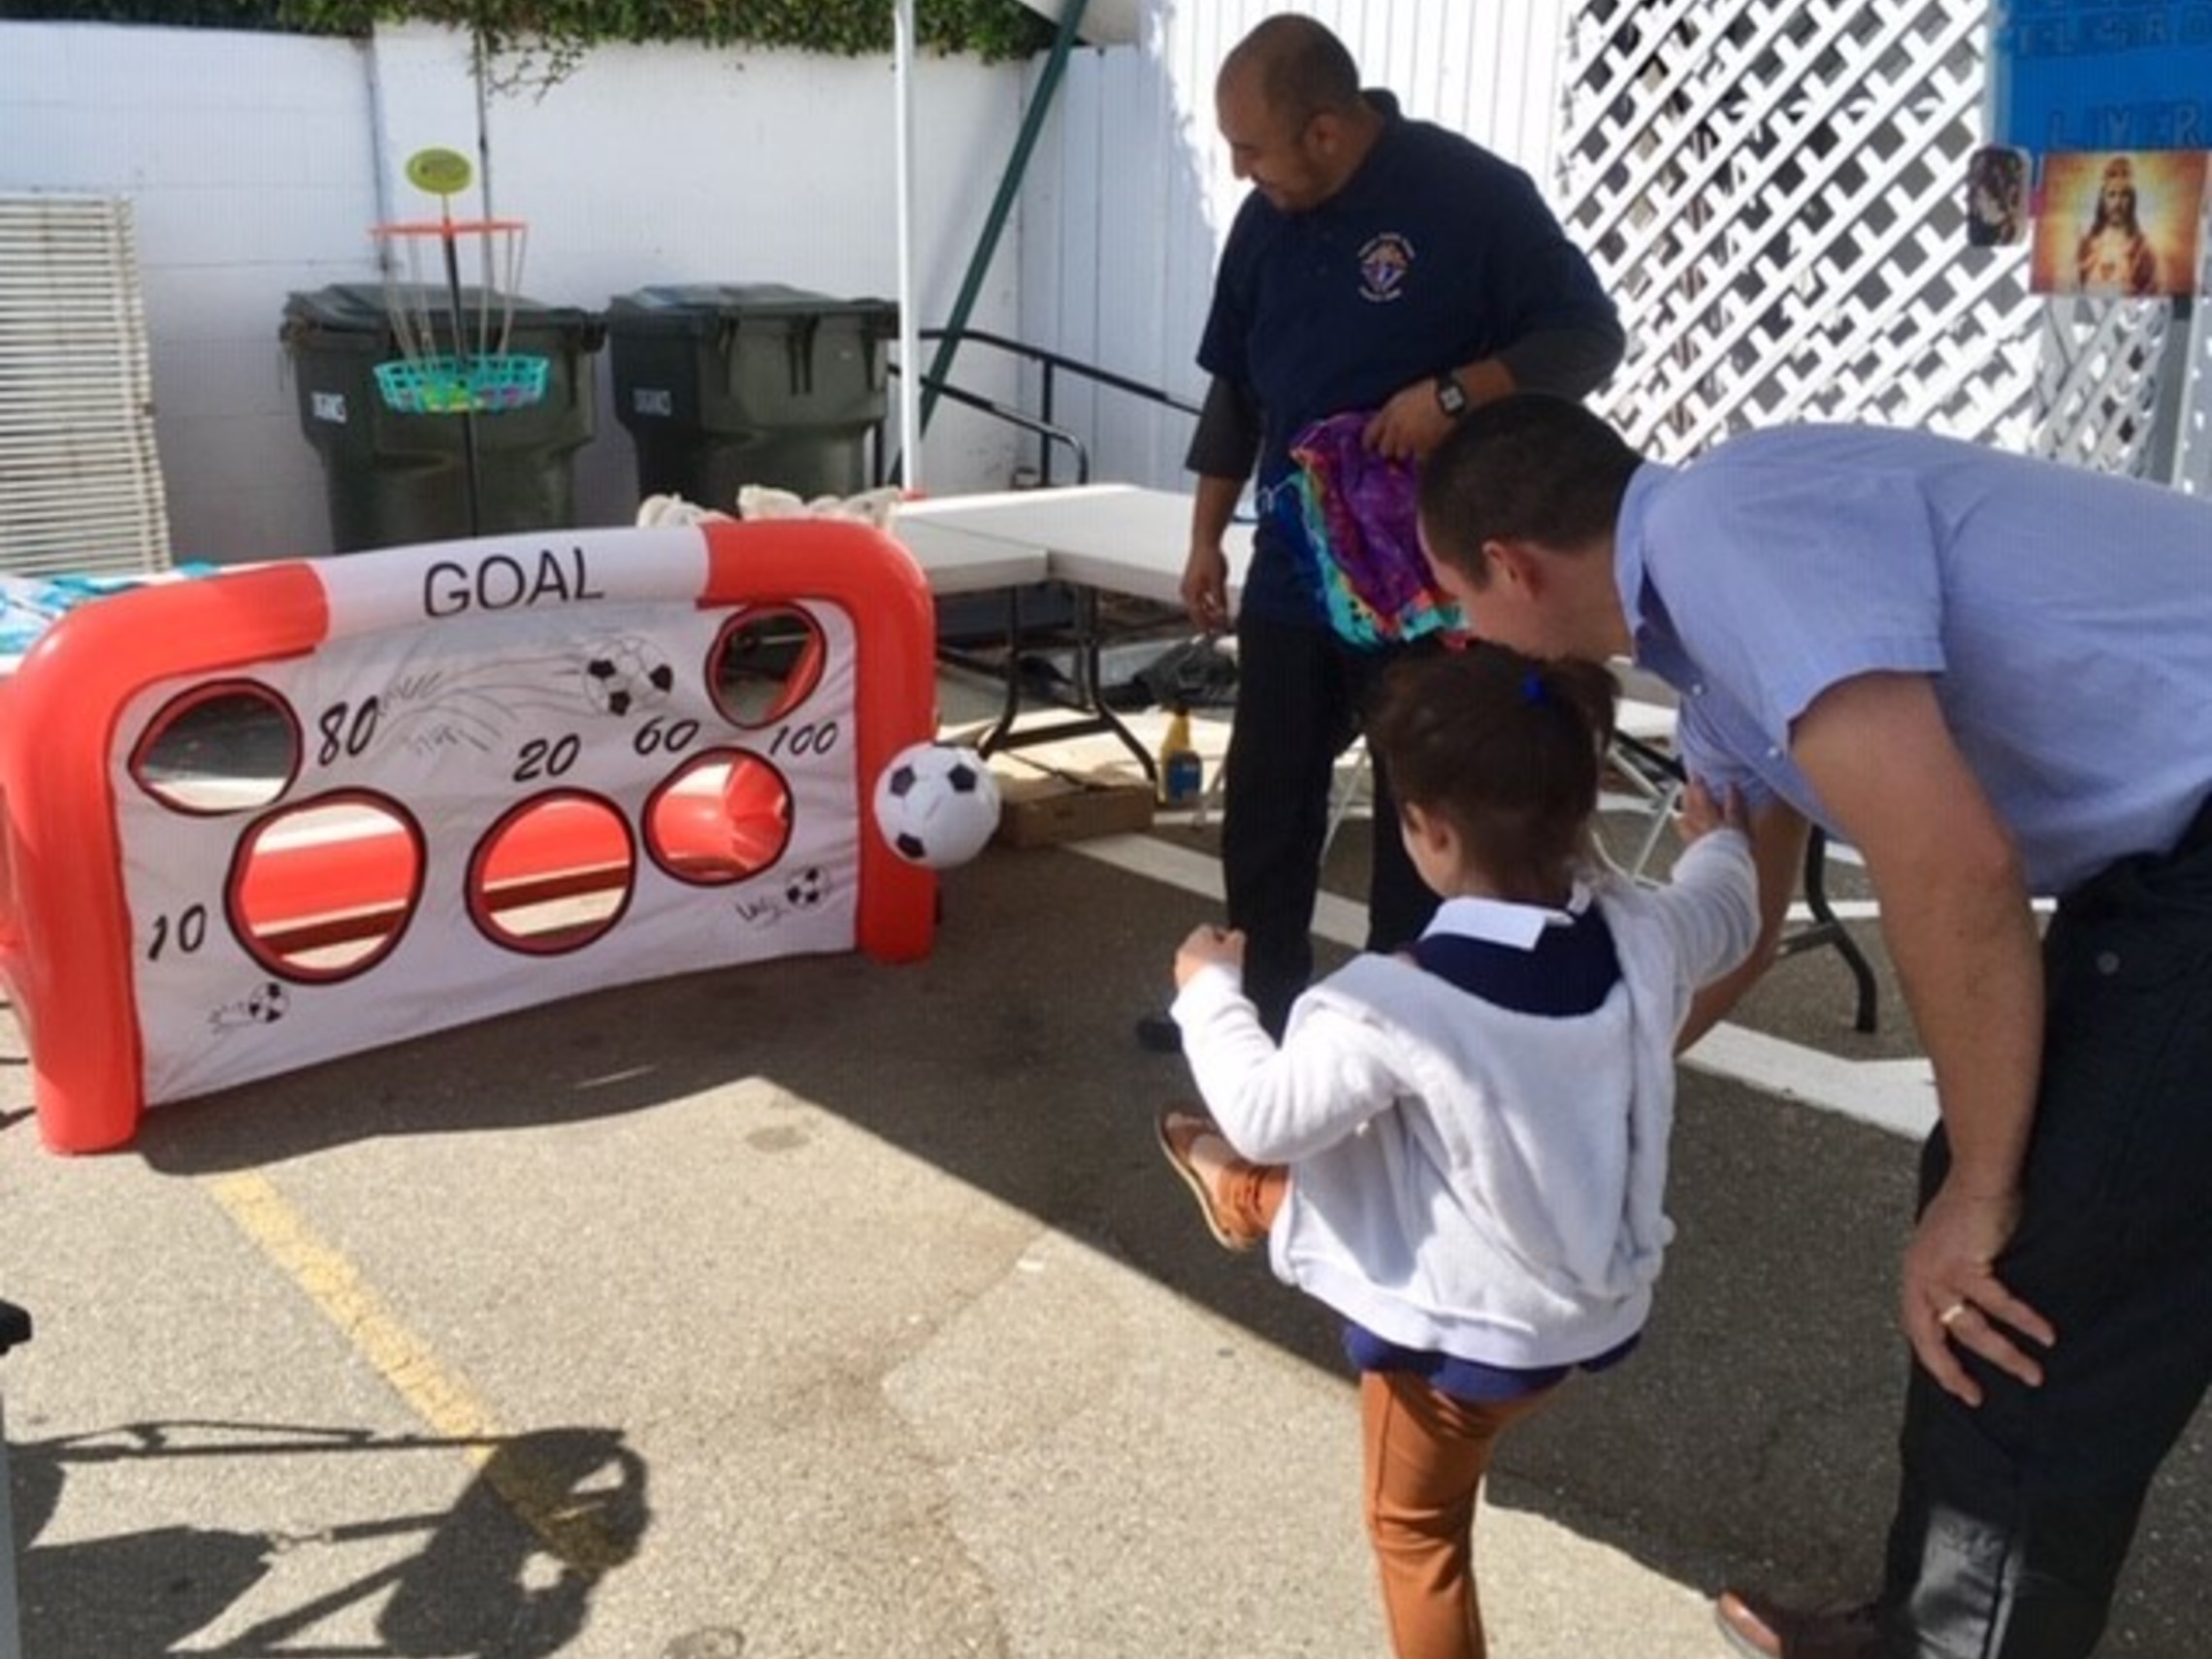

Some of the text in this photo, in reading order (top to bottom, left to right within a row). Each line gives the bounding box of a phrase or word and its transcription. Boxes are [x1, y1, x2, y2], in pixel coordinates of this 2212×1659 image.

[423, 546, 605, 619] GOAL
[317, 695, 379, 767] 80
[512, 732, 582, 783] 20
[634, 716, 701, 756] 60
[767, 721, 838, 757] 100
[147, 902, 208, 962] 10
